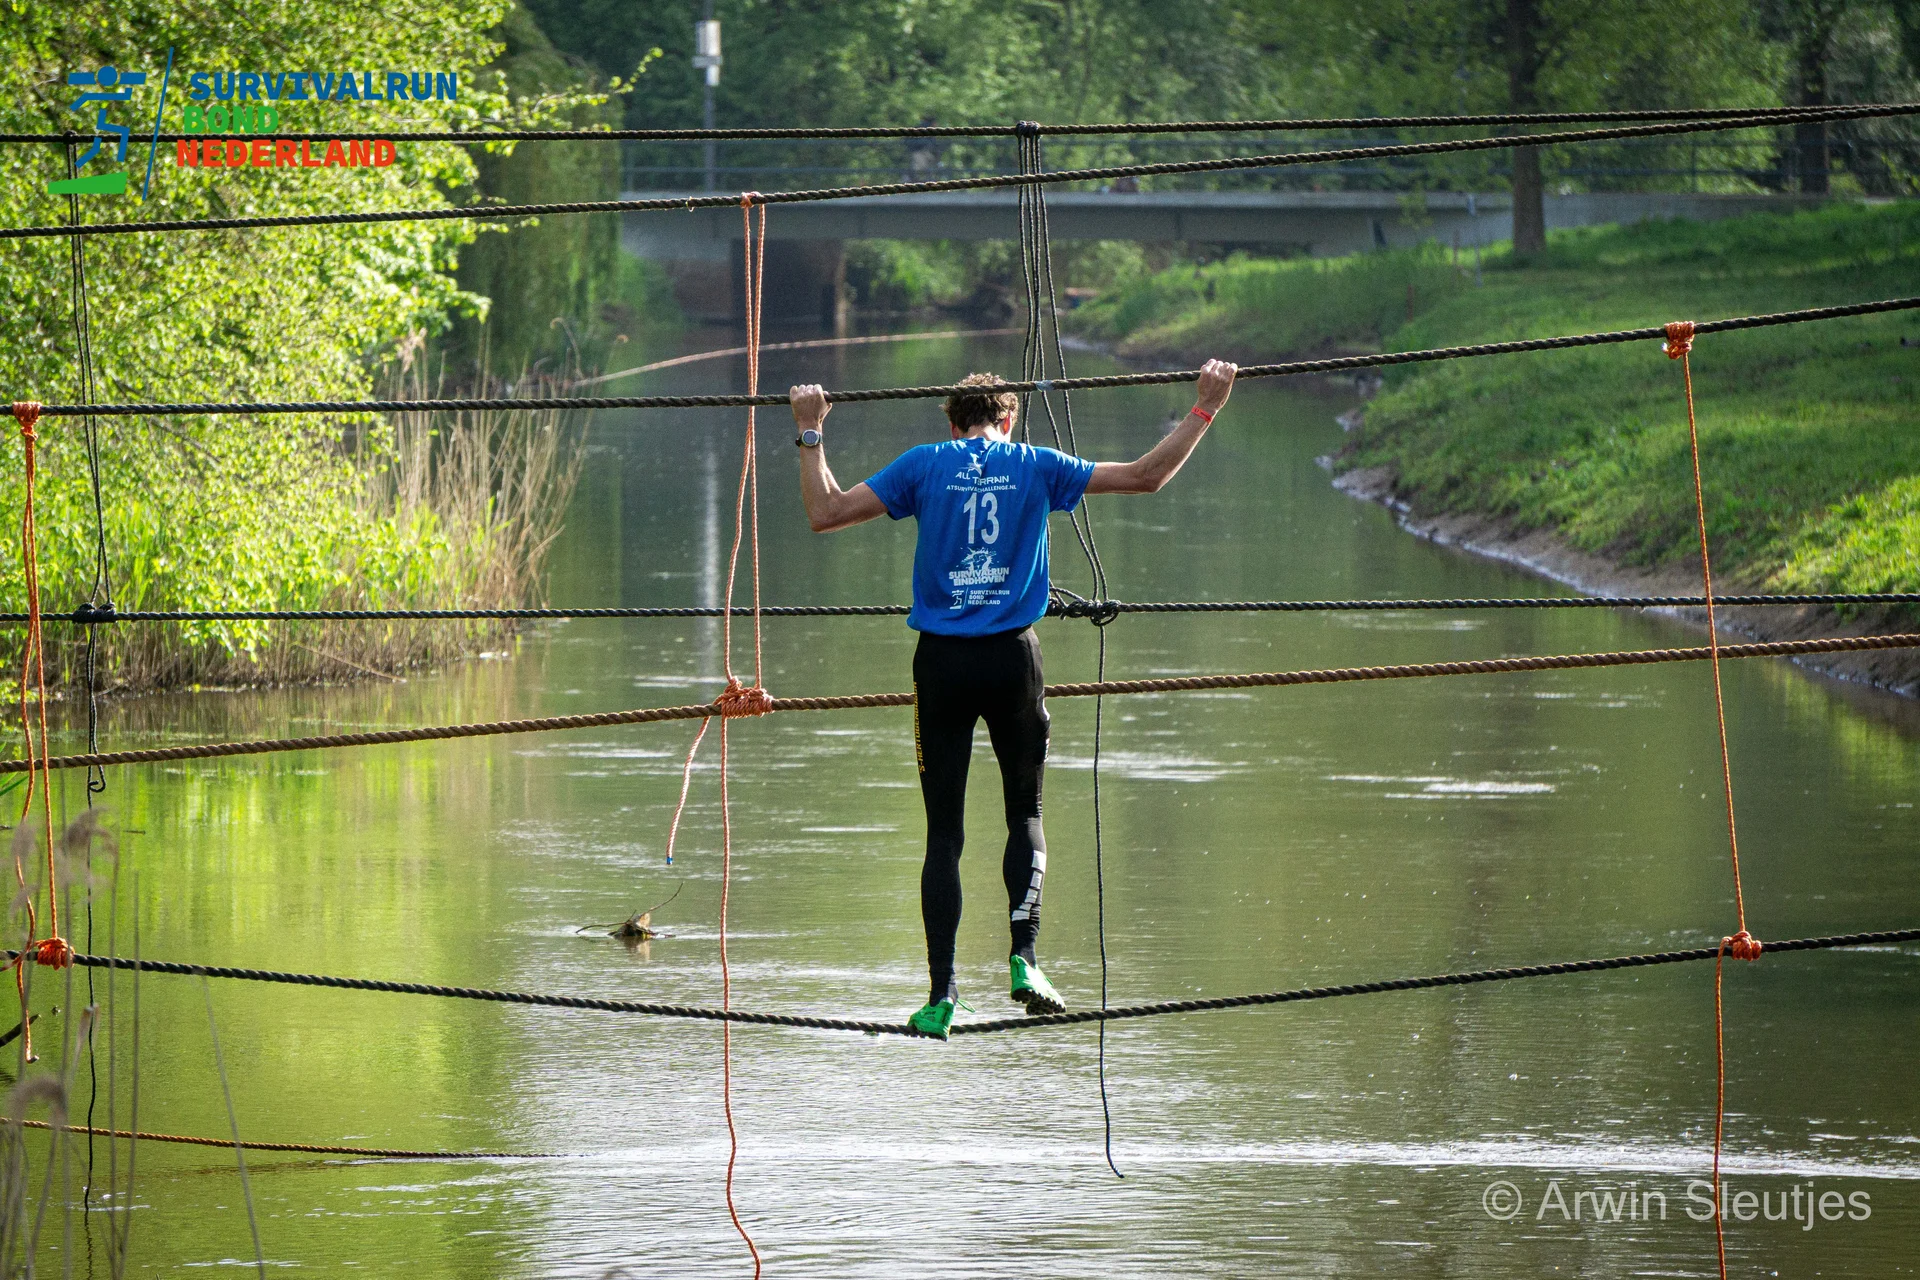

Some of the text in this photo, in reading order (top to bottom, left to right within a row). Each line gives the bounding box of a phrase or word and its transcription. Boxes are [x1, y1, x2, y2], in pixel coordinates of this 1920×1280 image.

[955, 471, 971, 480] ALL
[963, 492, 1000, 545] 13
[948, 567, 1010, 580] SURVIVALRUN
[953, 574, 1005, 586] EINDHOVEN
